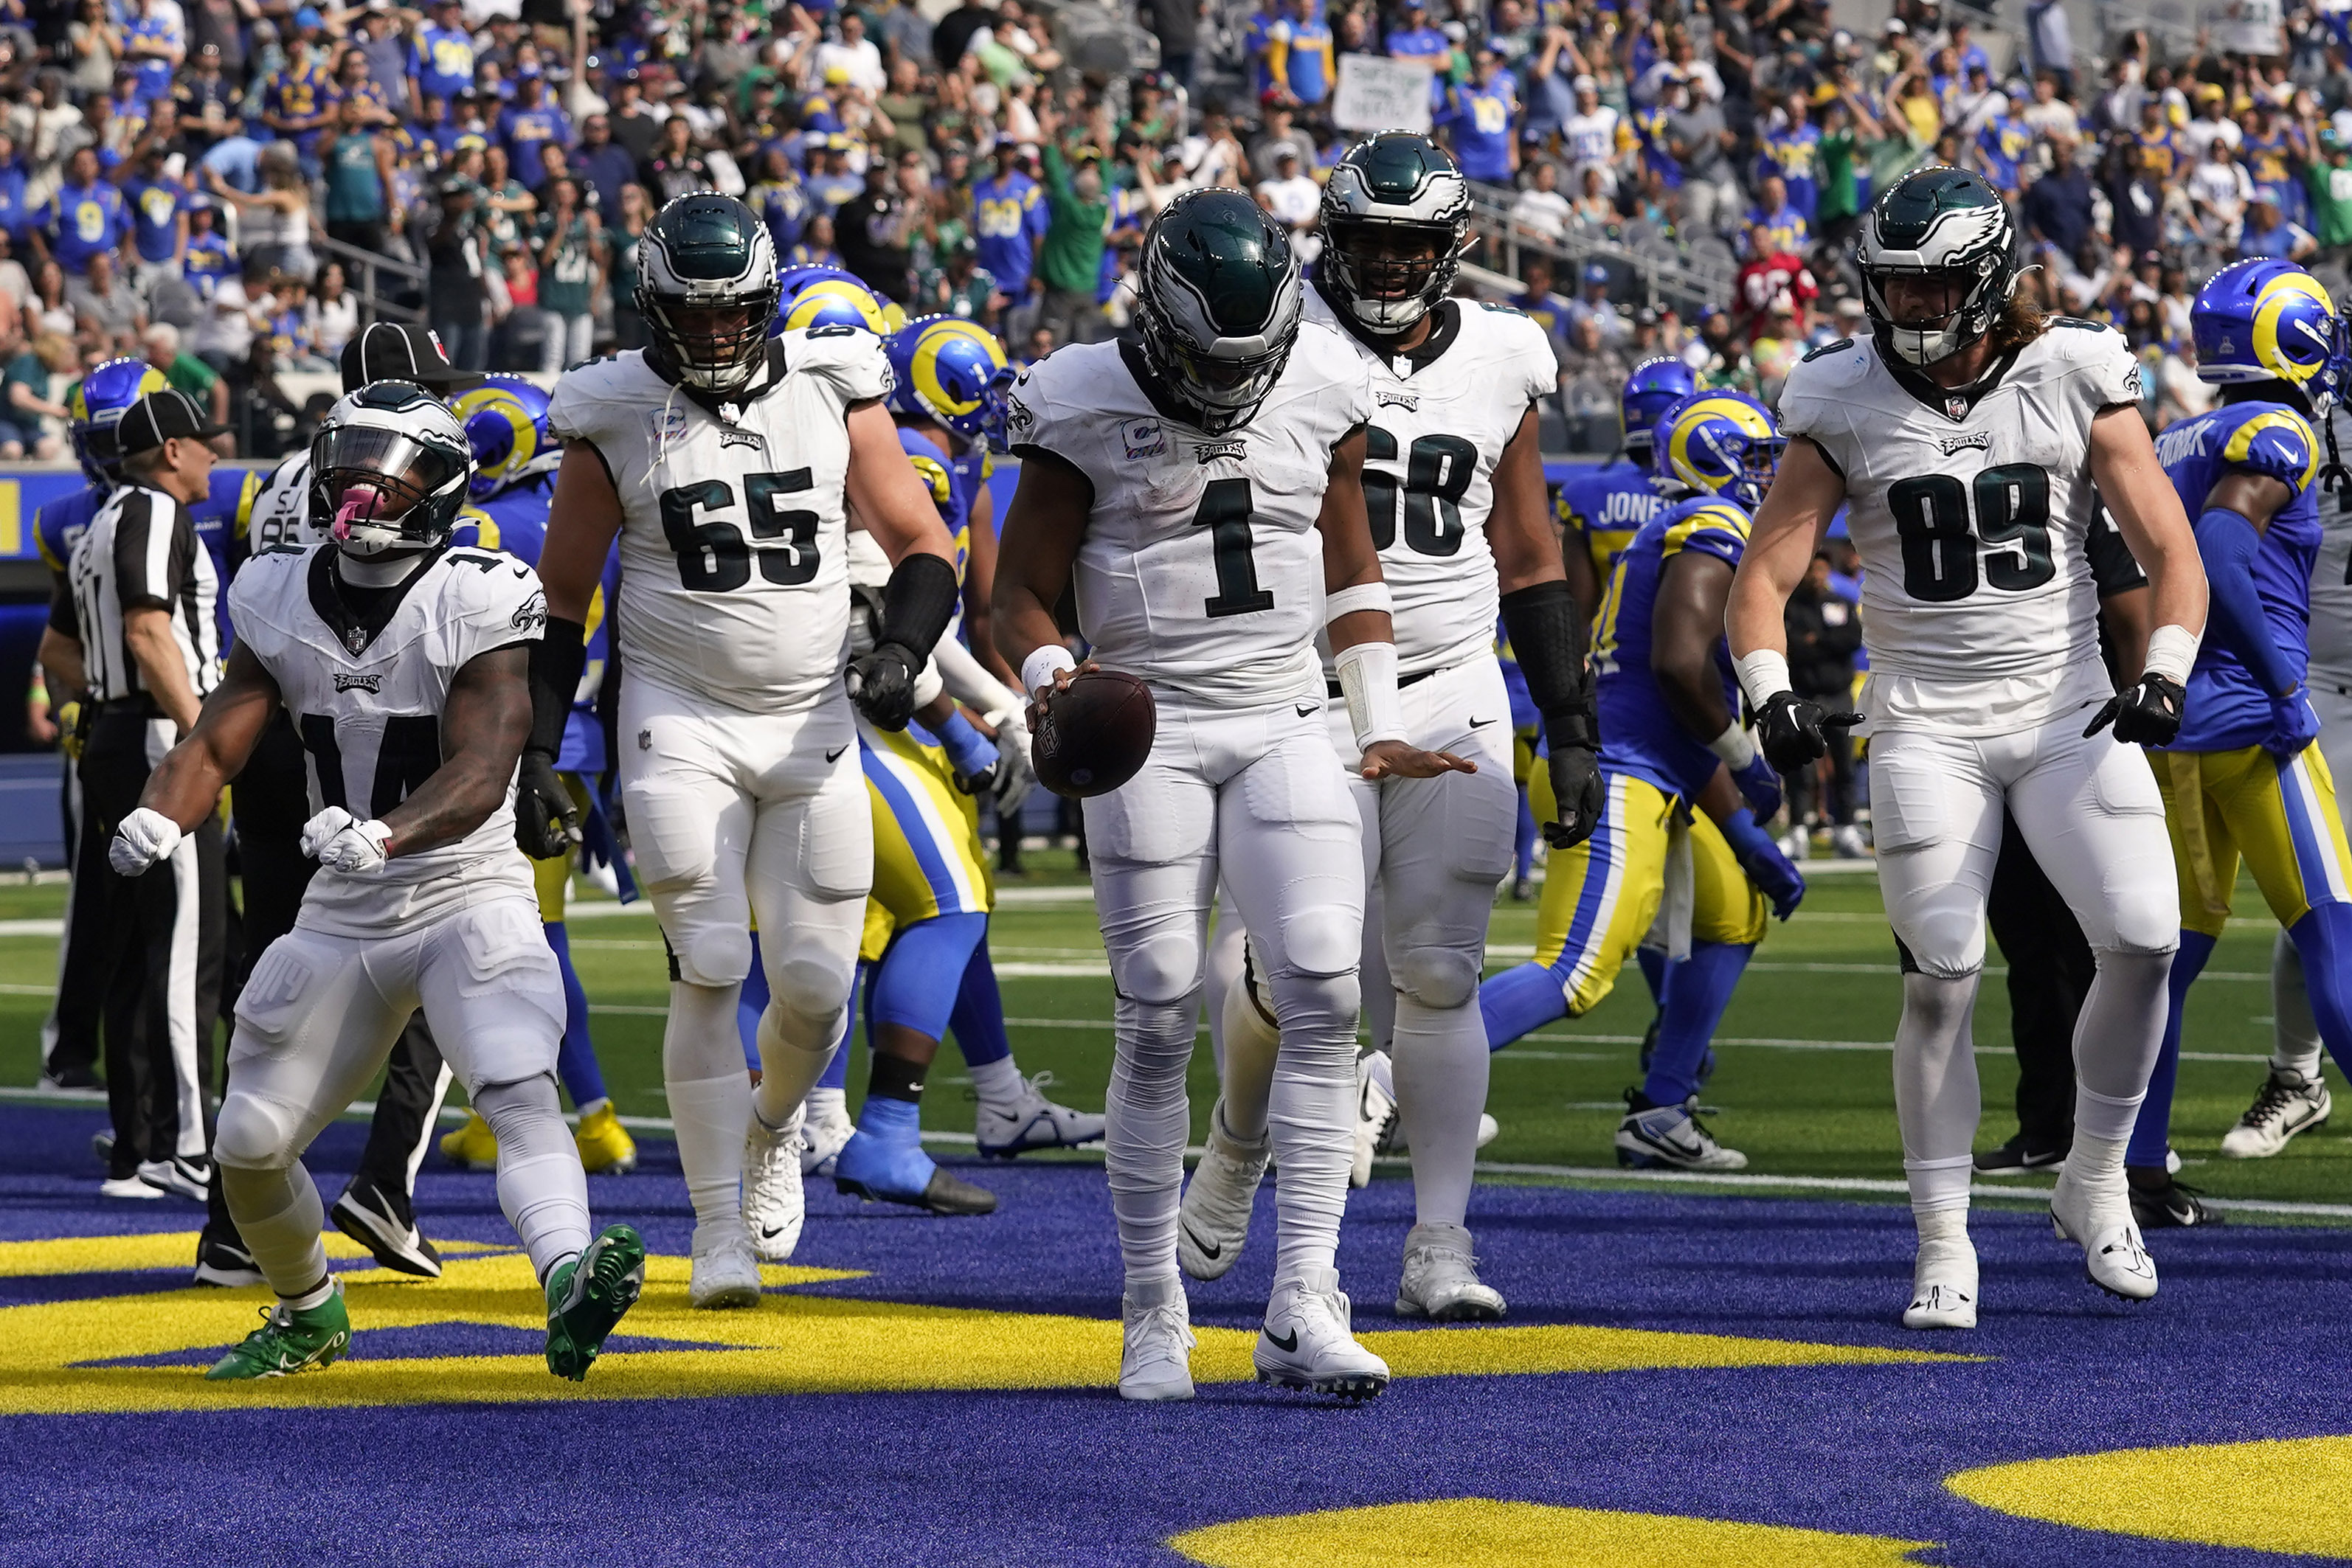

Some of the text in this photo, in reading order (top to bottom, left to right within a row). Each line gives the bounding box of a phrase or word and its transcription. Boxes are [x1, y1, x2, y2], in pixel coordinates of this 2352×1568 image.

[1375, 392, 1420, 413] EAGLES
[1192, 440, 1247, 465] EAGLES
[1940, 431, 1990, 457] EAGLES
[274, 490, 302, 514] SJ
[660, 467, 820, 592] 65
[1887, 462, 2056, 602] 89
[1190, 476, 1275, 618] 1
[333, 673, 383, 695] EAGLES
[300, 712, 442, 821] 14
